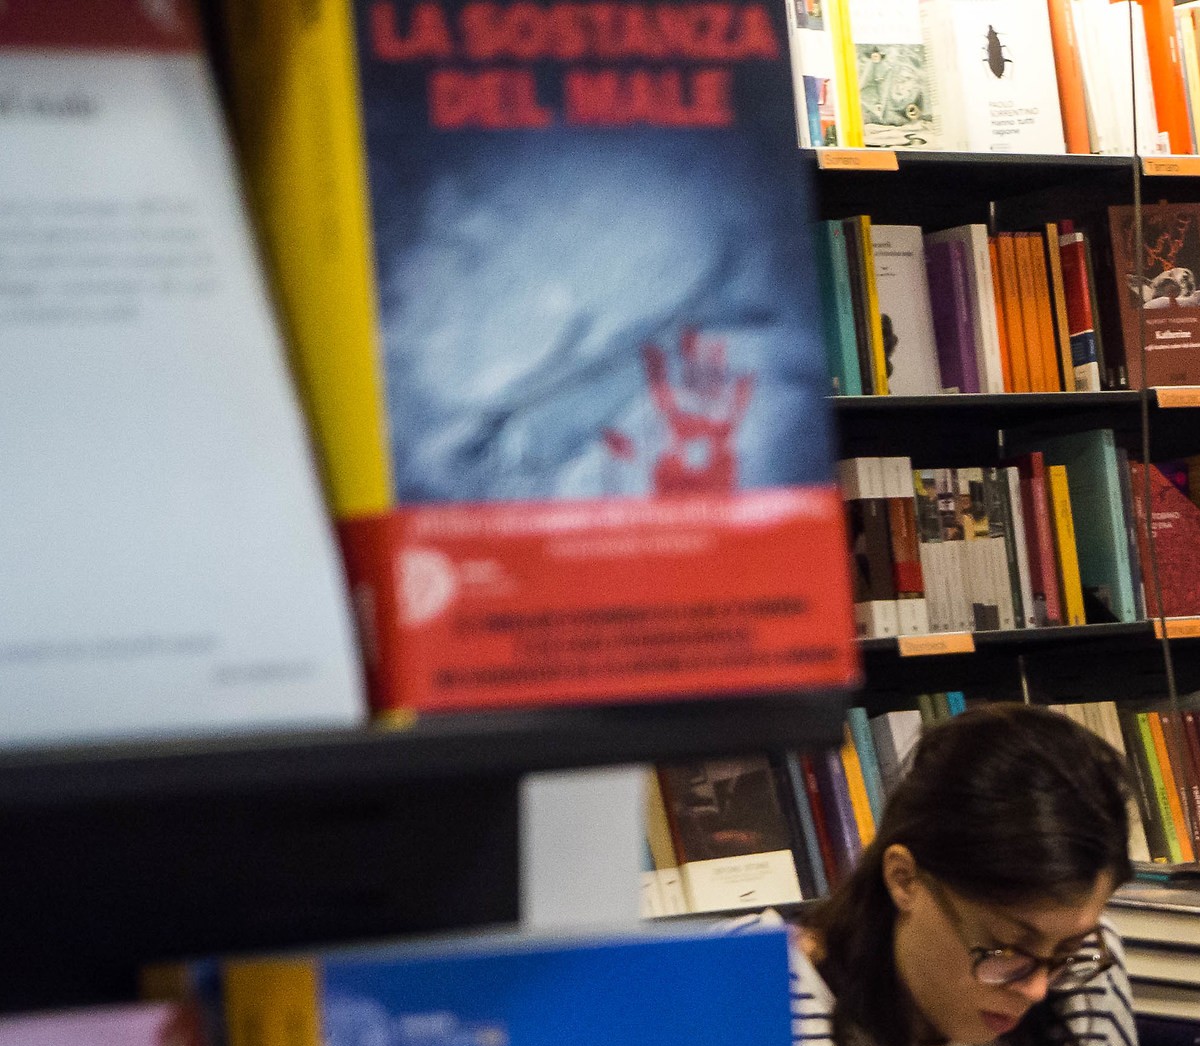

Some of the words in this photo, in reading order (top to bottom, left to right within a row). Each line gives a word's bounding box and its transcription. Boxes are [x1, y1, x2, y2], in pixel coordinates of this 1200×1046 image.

[370, 4, 452, 60] LA
[462, 3, 778, 59] SOSTANZA
[429, 69, 552, 129] DEL
[564, 69, 733, 128] MALE
